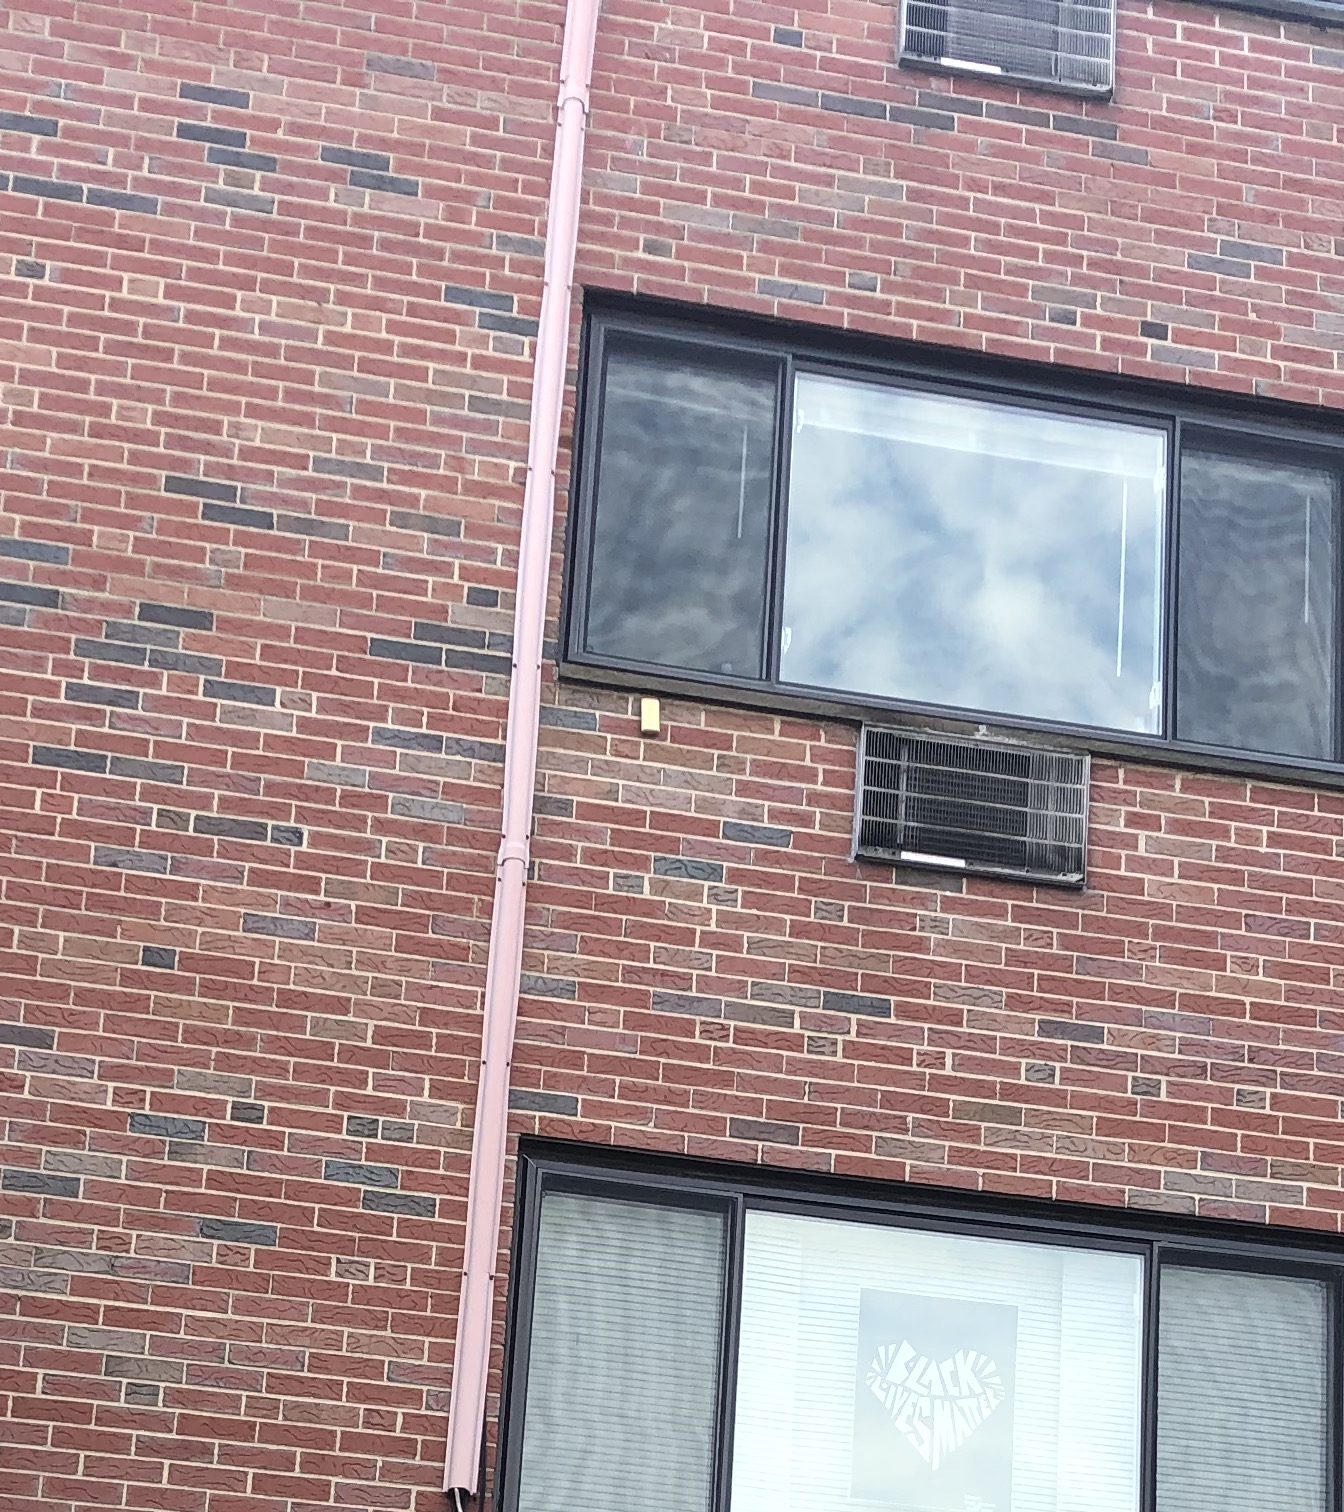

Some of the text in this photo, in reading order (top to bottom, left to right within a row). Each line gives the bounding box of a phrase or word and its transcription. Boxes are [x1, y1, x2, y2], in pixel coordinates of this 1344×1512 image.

[885, 1339, 984, 1397] BLACK
[870, 1375, 1005, 1472] LIVES MATTER
